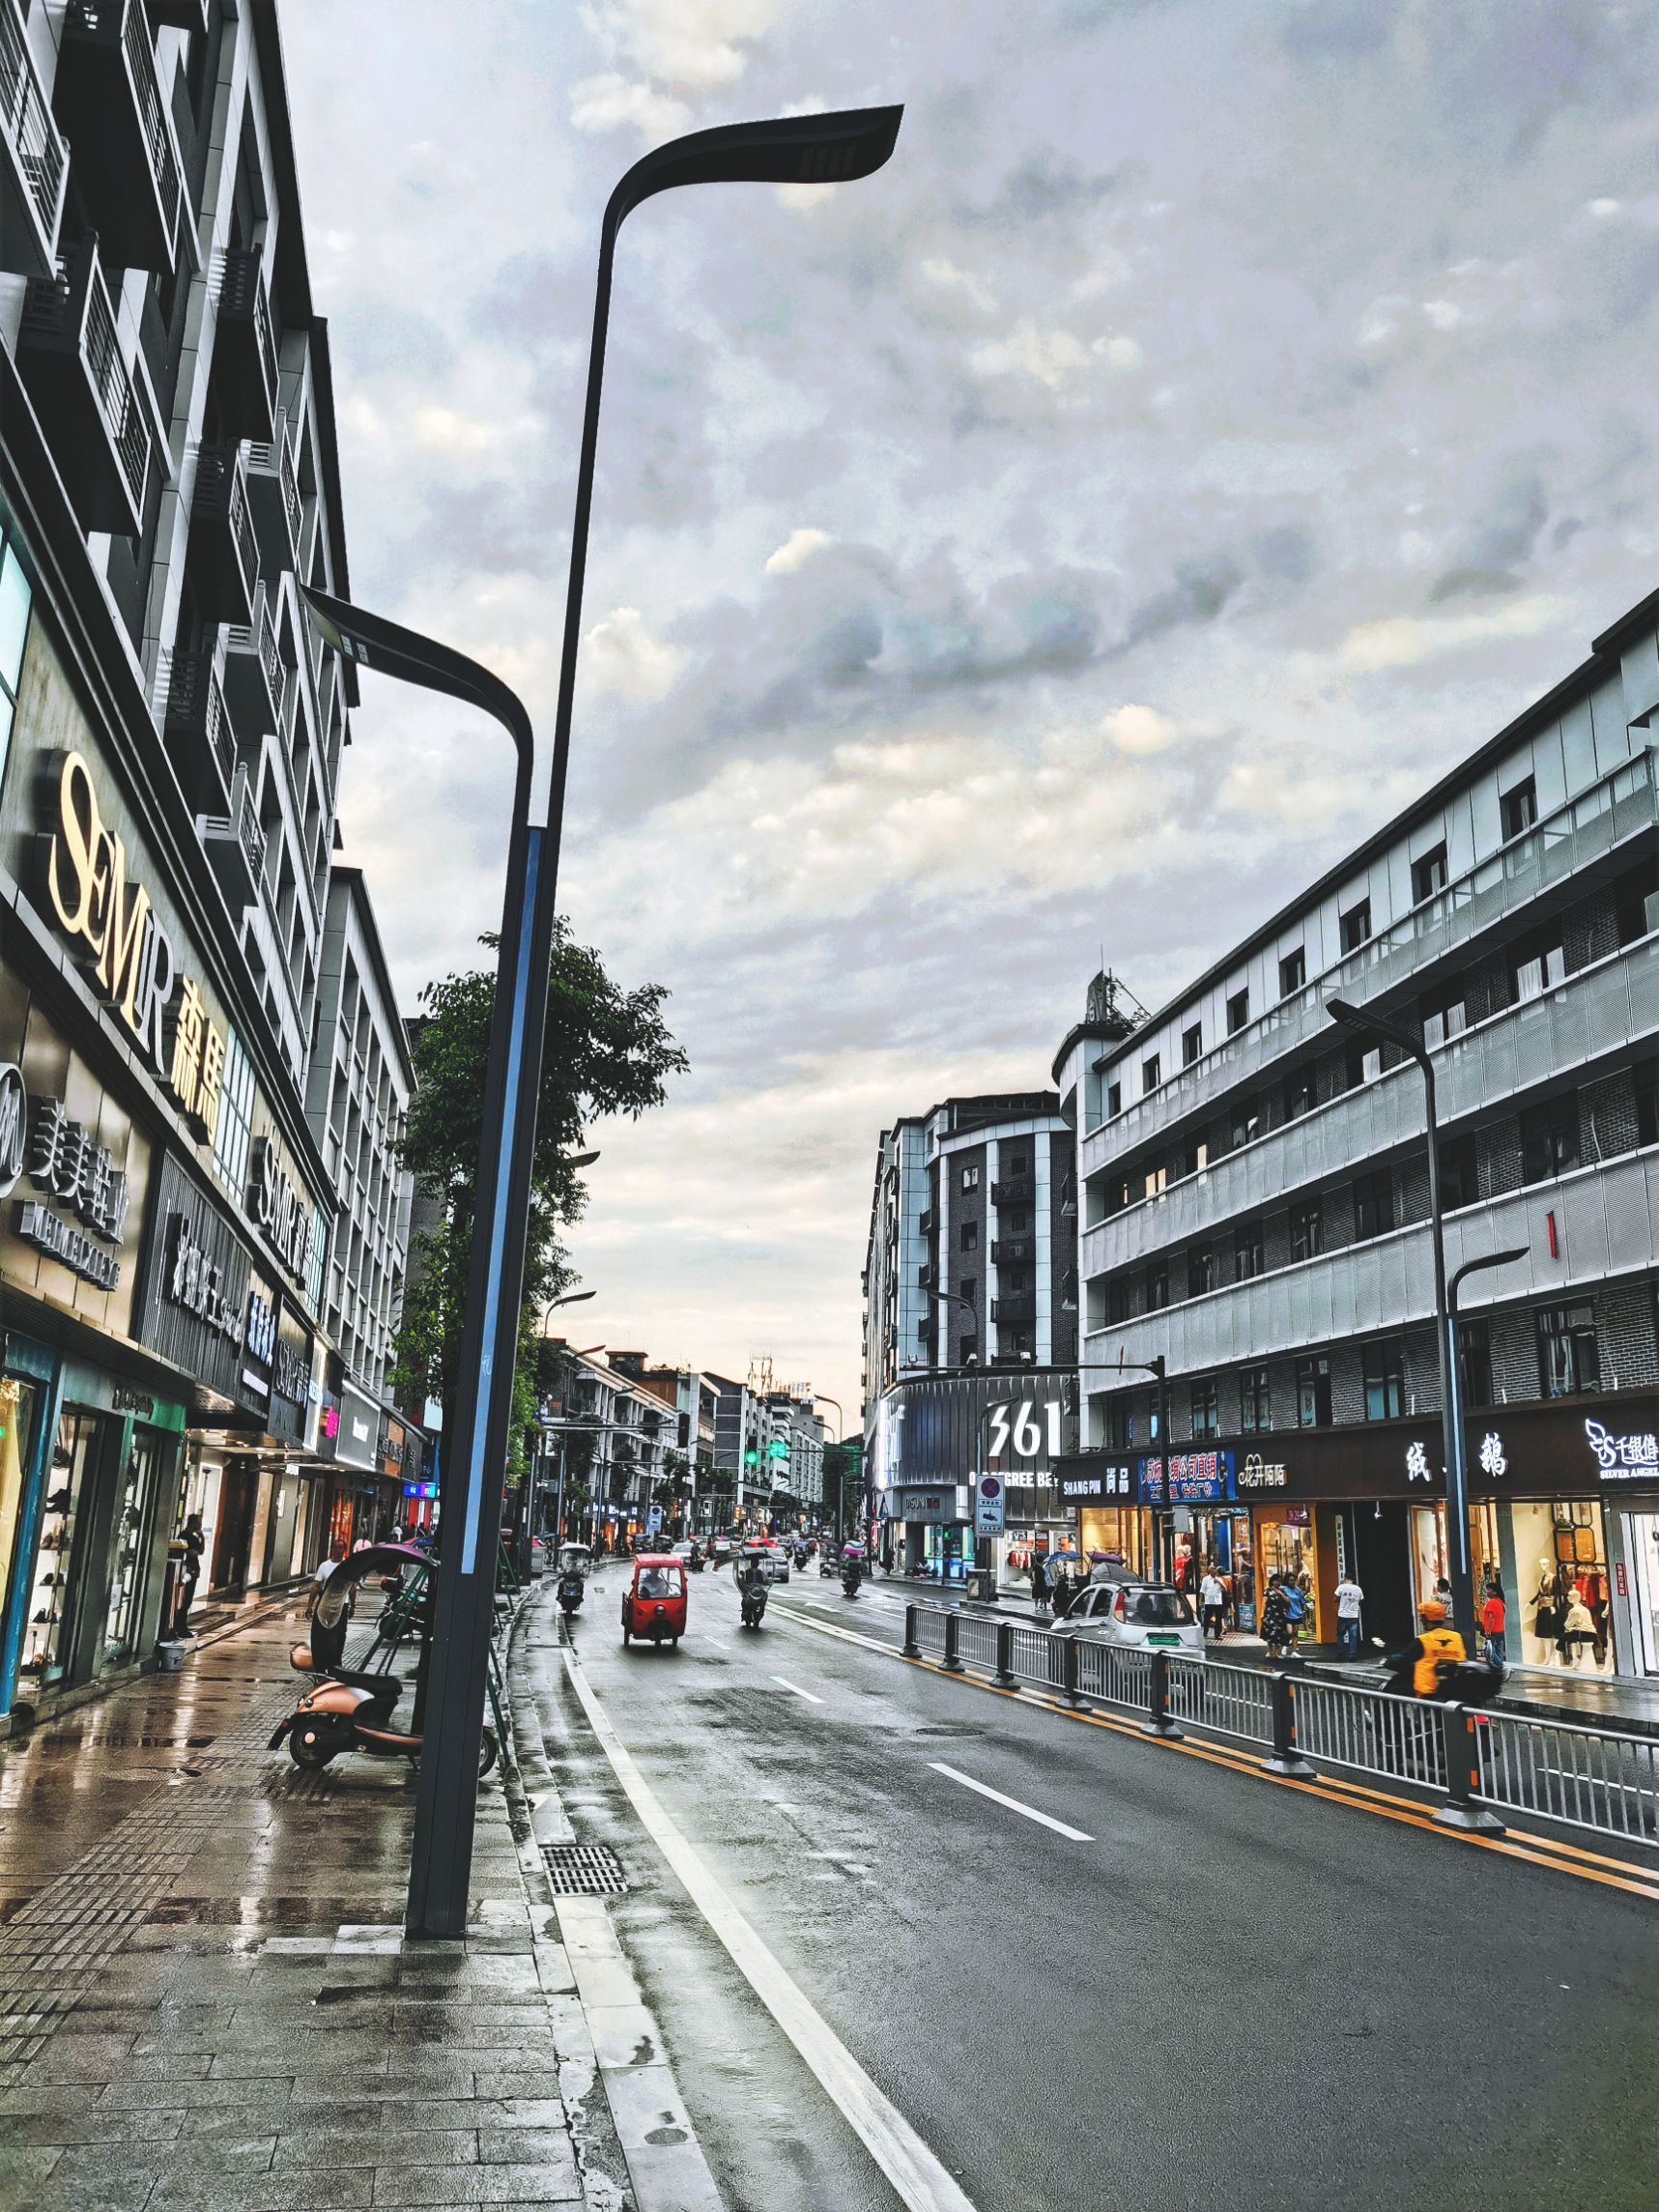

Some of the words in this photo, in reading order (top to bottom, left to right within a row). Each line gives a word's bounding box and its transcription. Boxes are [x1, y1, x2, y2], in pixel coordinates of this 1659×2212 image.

[31, 1102, 129, 1245] 美美鞋业
[987, 1400, 1061, 1456] 361
[1406, 1432, 1507, 1481] 绒鹅
[1600, 1469, 1630, 1479] SILVER
[1063, 1480, 1088, 1496] SHANG
[1089, 1479, 1101, 1494] PIN
[1106, 1467, 1129, 1494] 尚品
